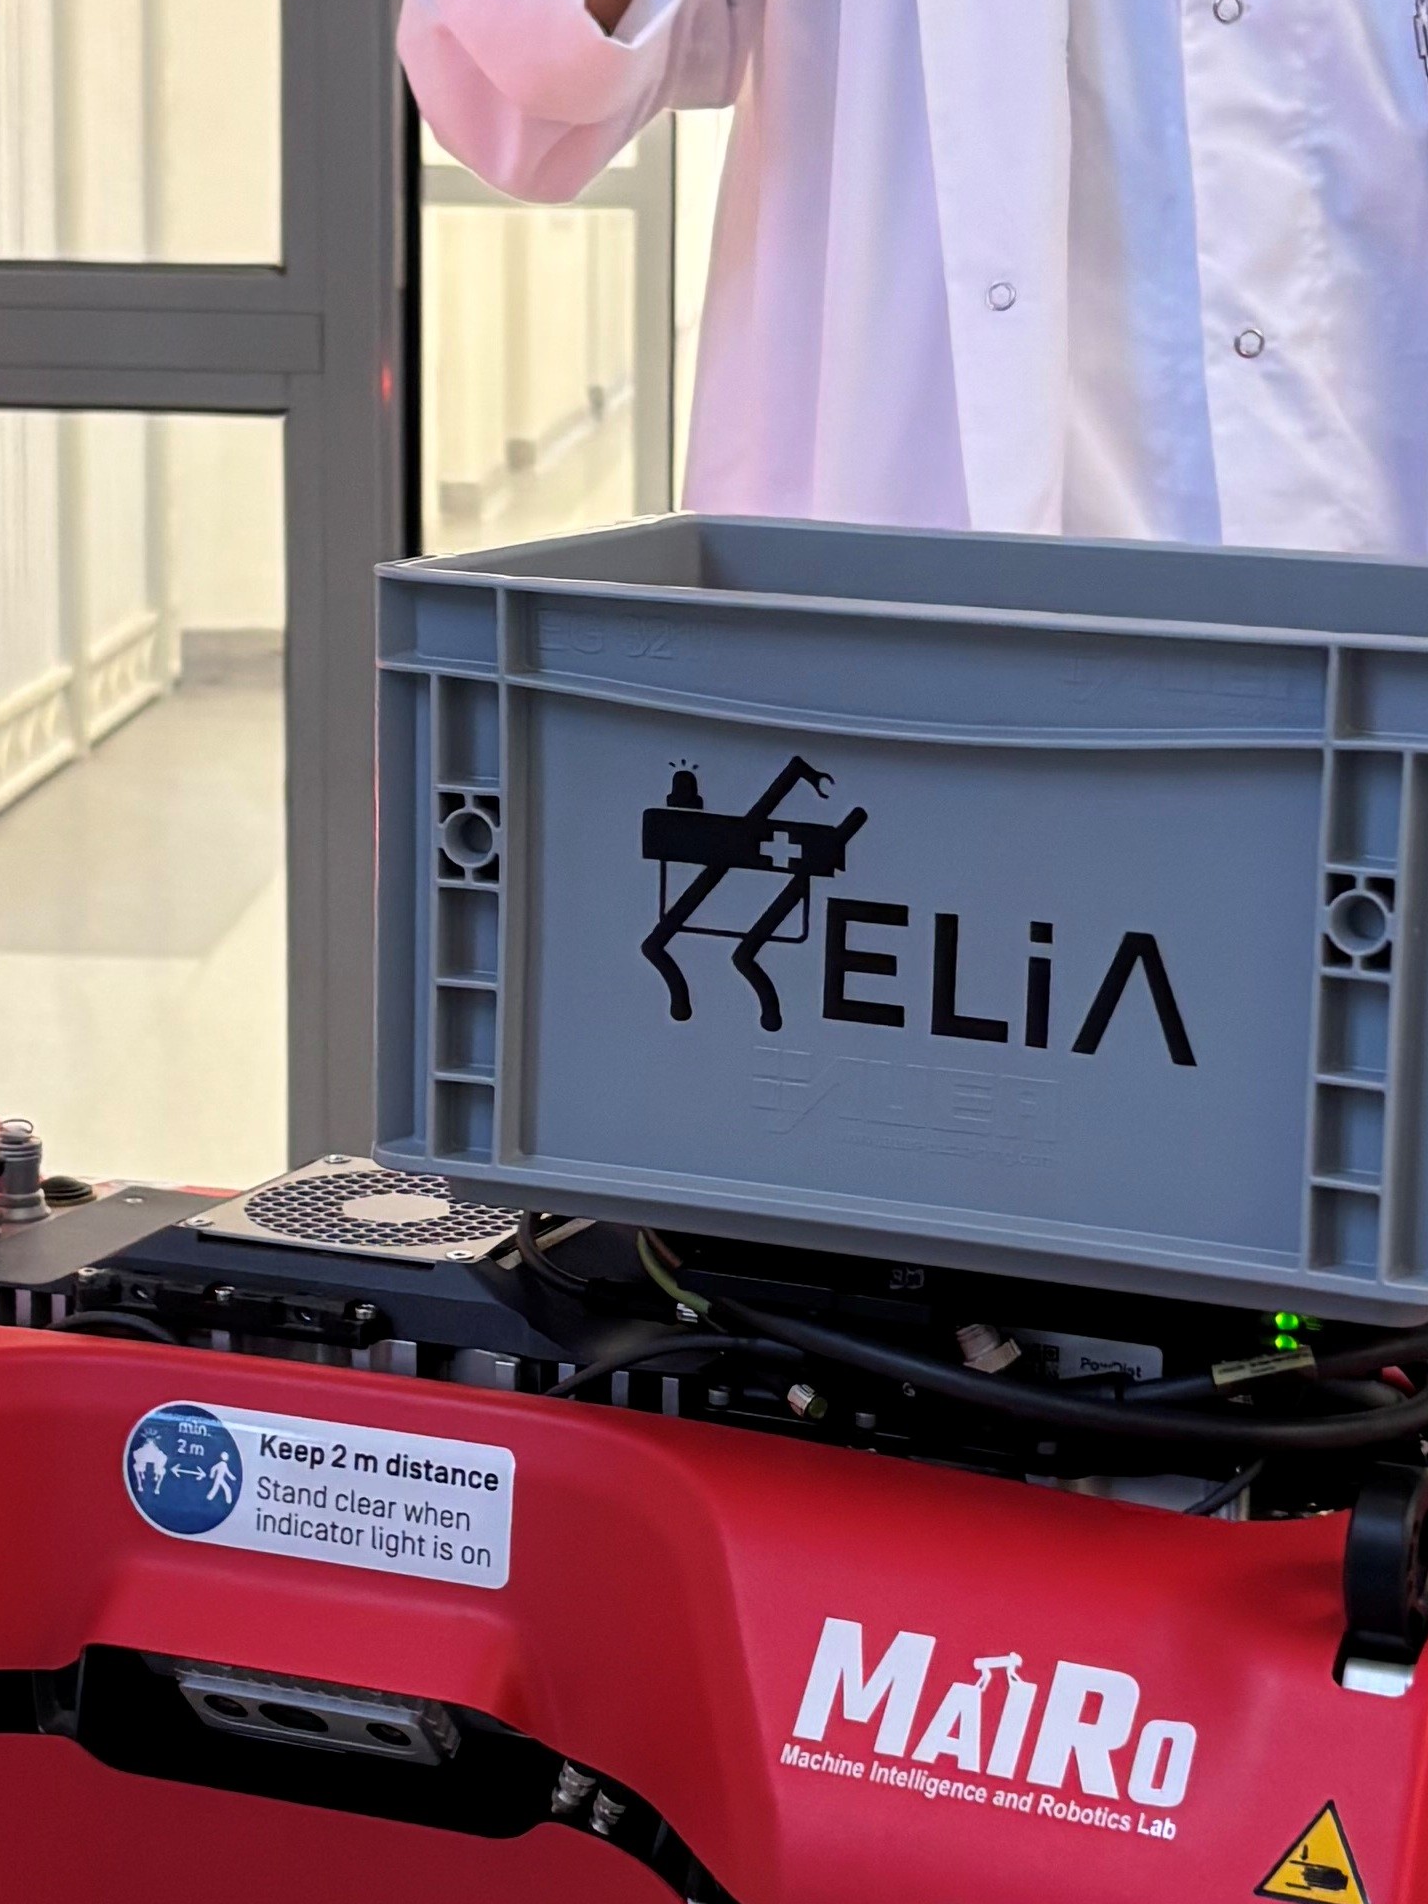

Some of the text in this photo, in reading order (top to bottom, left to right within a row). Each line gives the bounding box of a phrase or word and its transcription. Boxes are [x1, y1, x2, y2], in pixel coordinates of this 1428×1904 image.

[177, 1439, 205, 1456] 2 m
[178, 1420, 212, 1437] min.
[259, 1433, 500, 1491] Keep 2 m distance
[256, 1476, 471, 1531] Stand clear when
[255, 1508, 492, 1568] indicator light is on
[780, 1742, 1177, 1841] Machine Intelligence and Robotics Lab
